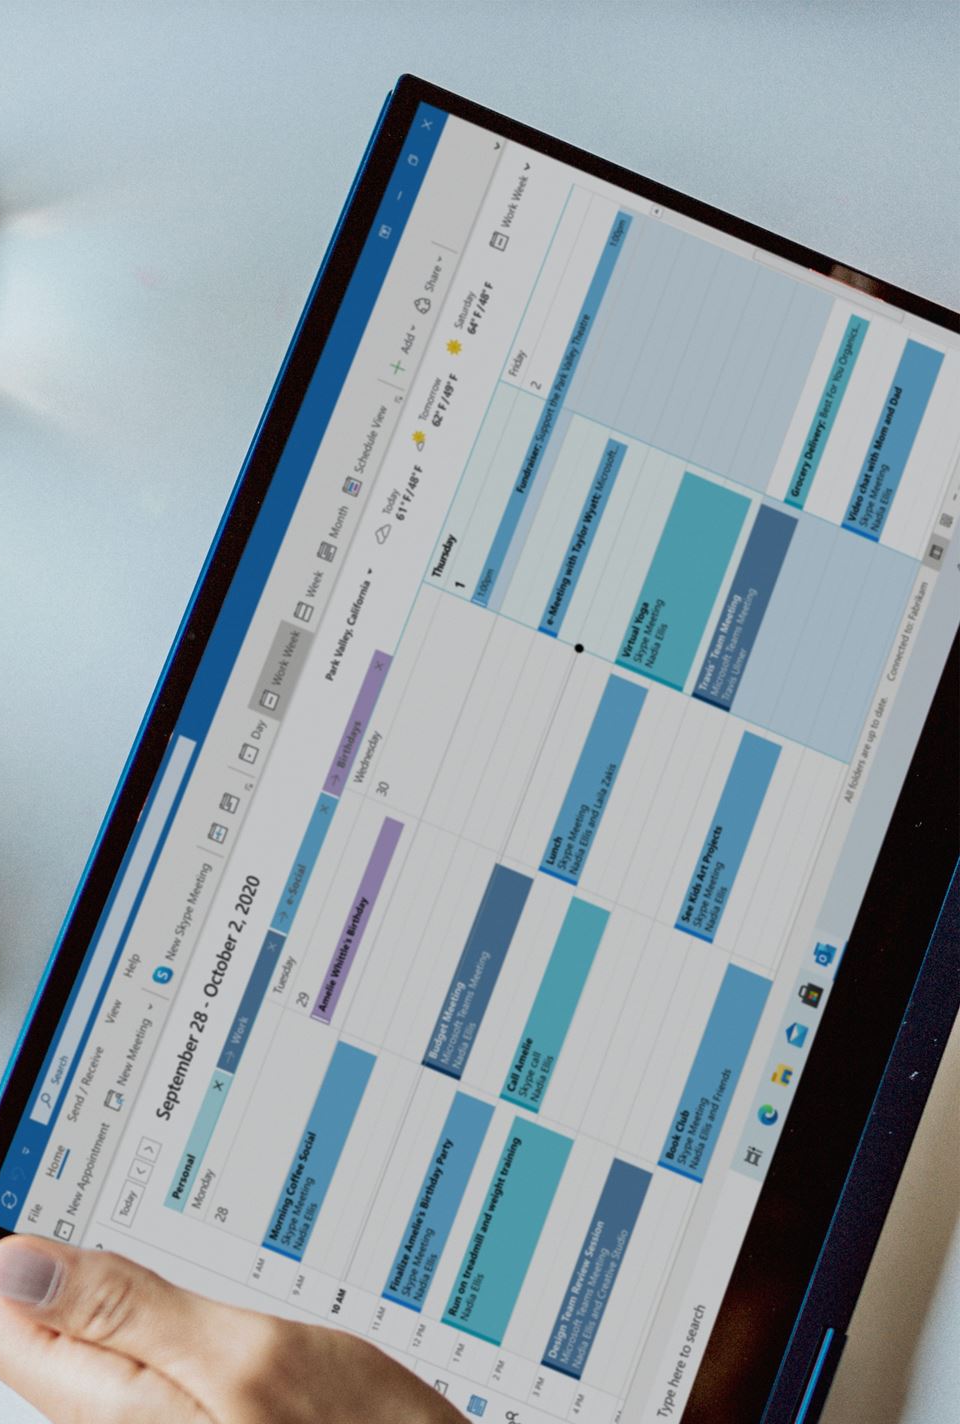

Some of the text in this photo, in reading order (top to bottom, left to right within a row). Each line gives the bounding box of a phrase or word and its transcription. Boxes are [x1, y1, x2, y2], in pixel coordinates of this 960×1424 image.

[500, 175, 528, 228] Work Week
[423, 264, 442, 292] Share
[453, 290, 477, 329] Saturday
[571, 313, 590, 345] Theatre
[400, 332, 415, 354] Add
[507, 349, 528, 377] Friday
[561, 346, 579, 371] Valley
[417, 376, 442, 421] Tomorrow
[529, 380, 542, 390] 2
[549, 392, 560, 407] the
[554, 373, 568, 391] Park
[353, 405, 387, 474] Schedule View
[535, 407, 554, 442] Support
[790, 460, 812, 497] Grocery
[818, 399, 832, 418] Best
[825, 383, 837, 398] For
[831, 366, 844, 381] You
[847, 385, 902, 521] Video chat with Mom and Dad
[328, 505, 349, 539] Month
[381, 488, 401, 514] Today
[431, 533, 457, 577] Thursday
[546, 576, 571, 626] e-Meeting
[564, 554, 578, 576] with
[571, 524, 588, 553] Taylor
[305, 570, 323, 597] Week
[324, 580, 371, 681] Park Valley, California
[709, 634, 726, 658] Team
[719, 594, 742, 633] Meeting
[886, 581, 928, 682] Connected to: Fabrikam
[271, 630, 300, 685] Work Week
[249, 719, 268, 740] Day
[336, 720, 361, 769] Birthdays
[843, 694, 888, 803] All folders are up to date.
[352, 730, 383, 783] Wednesday
[375, 780, 390, 797] 30
[545, 836, 563, 865] Lunch
[234, 874, 260, 916] 2020
[286, 863, 306, 905] e-Social
[680, 825, 723, 922] See Kids Art Projects
[164, 862, 213, 961] New Skype Meeting
[227, 919, 247, 933] 2,
[122, 953, 141, 978] Help
[203, 933, 237, 998] October
[272, 955, 297, 993] Tuesday
[317, 896, 369, 1012] Amelie Whittle's Birthday
[104, 999, 122, 1023] View
[189, 1010, 208, 1033] 28
[295, 991, 310, 1008] 29
[427, 981, 466, 1059] Budget Meeting
[115, 1017, 153, 1086] New Meeting
[230, 1016, 248, 1044] Work
[50, 1055, 68, 1085] Search
[66, 1094, 85, 1122] Send
[80, 1045, 104, 1086] Receive
[155, 1033, 199, 1121] September
[506, 1037, 533, 1092] Call Amelie
[664, 1109, 690, 1160] Book Club
[45, 1144, 65, 1178] Home
[65, 1122, 110, 1216] New Appointment
[171, 1153, 196, 1200] Personal
[118, 1190, 138, 1216] Today
[190, 1168, 216, 1209] Monday
[268, 1130, 316, 1241] Morning Coffee Social
[27, 1203, 42, 1223] File
[214, 1206, 229, 1223] 28
[280, 1176, 315, 1246] Skype Meeting
[292, 1202, 317, 1251] Nadia Ellis
[388, 1138, 454, 1292] Finalize Amelie's Birthday Party
[447, 1136, 522, 1317] Run on treadmill and weight training
[330, 1288, 346, 1314] 10 AM
[547, 1220, 604, 1359] Design Team Review Session
[655, 1304, 706, 1417] Type here to search
